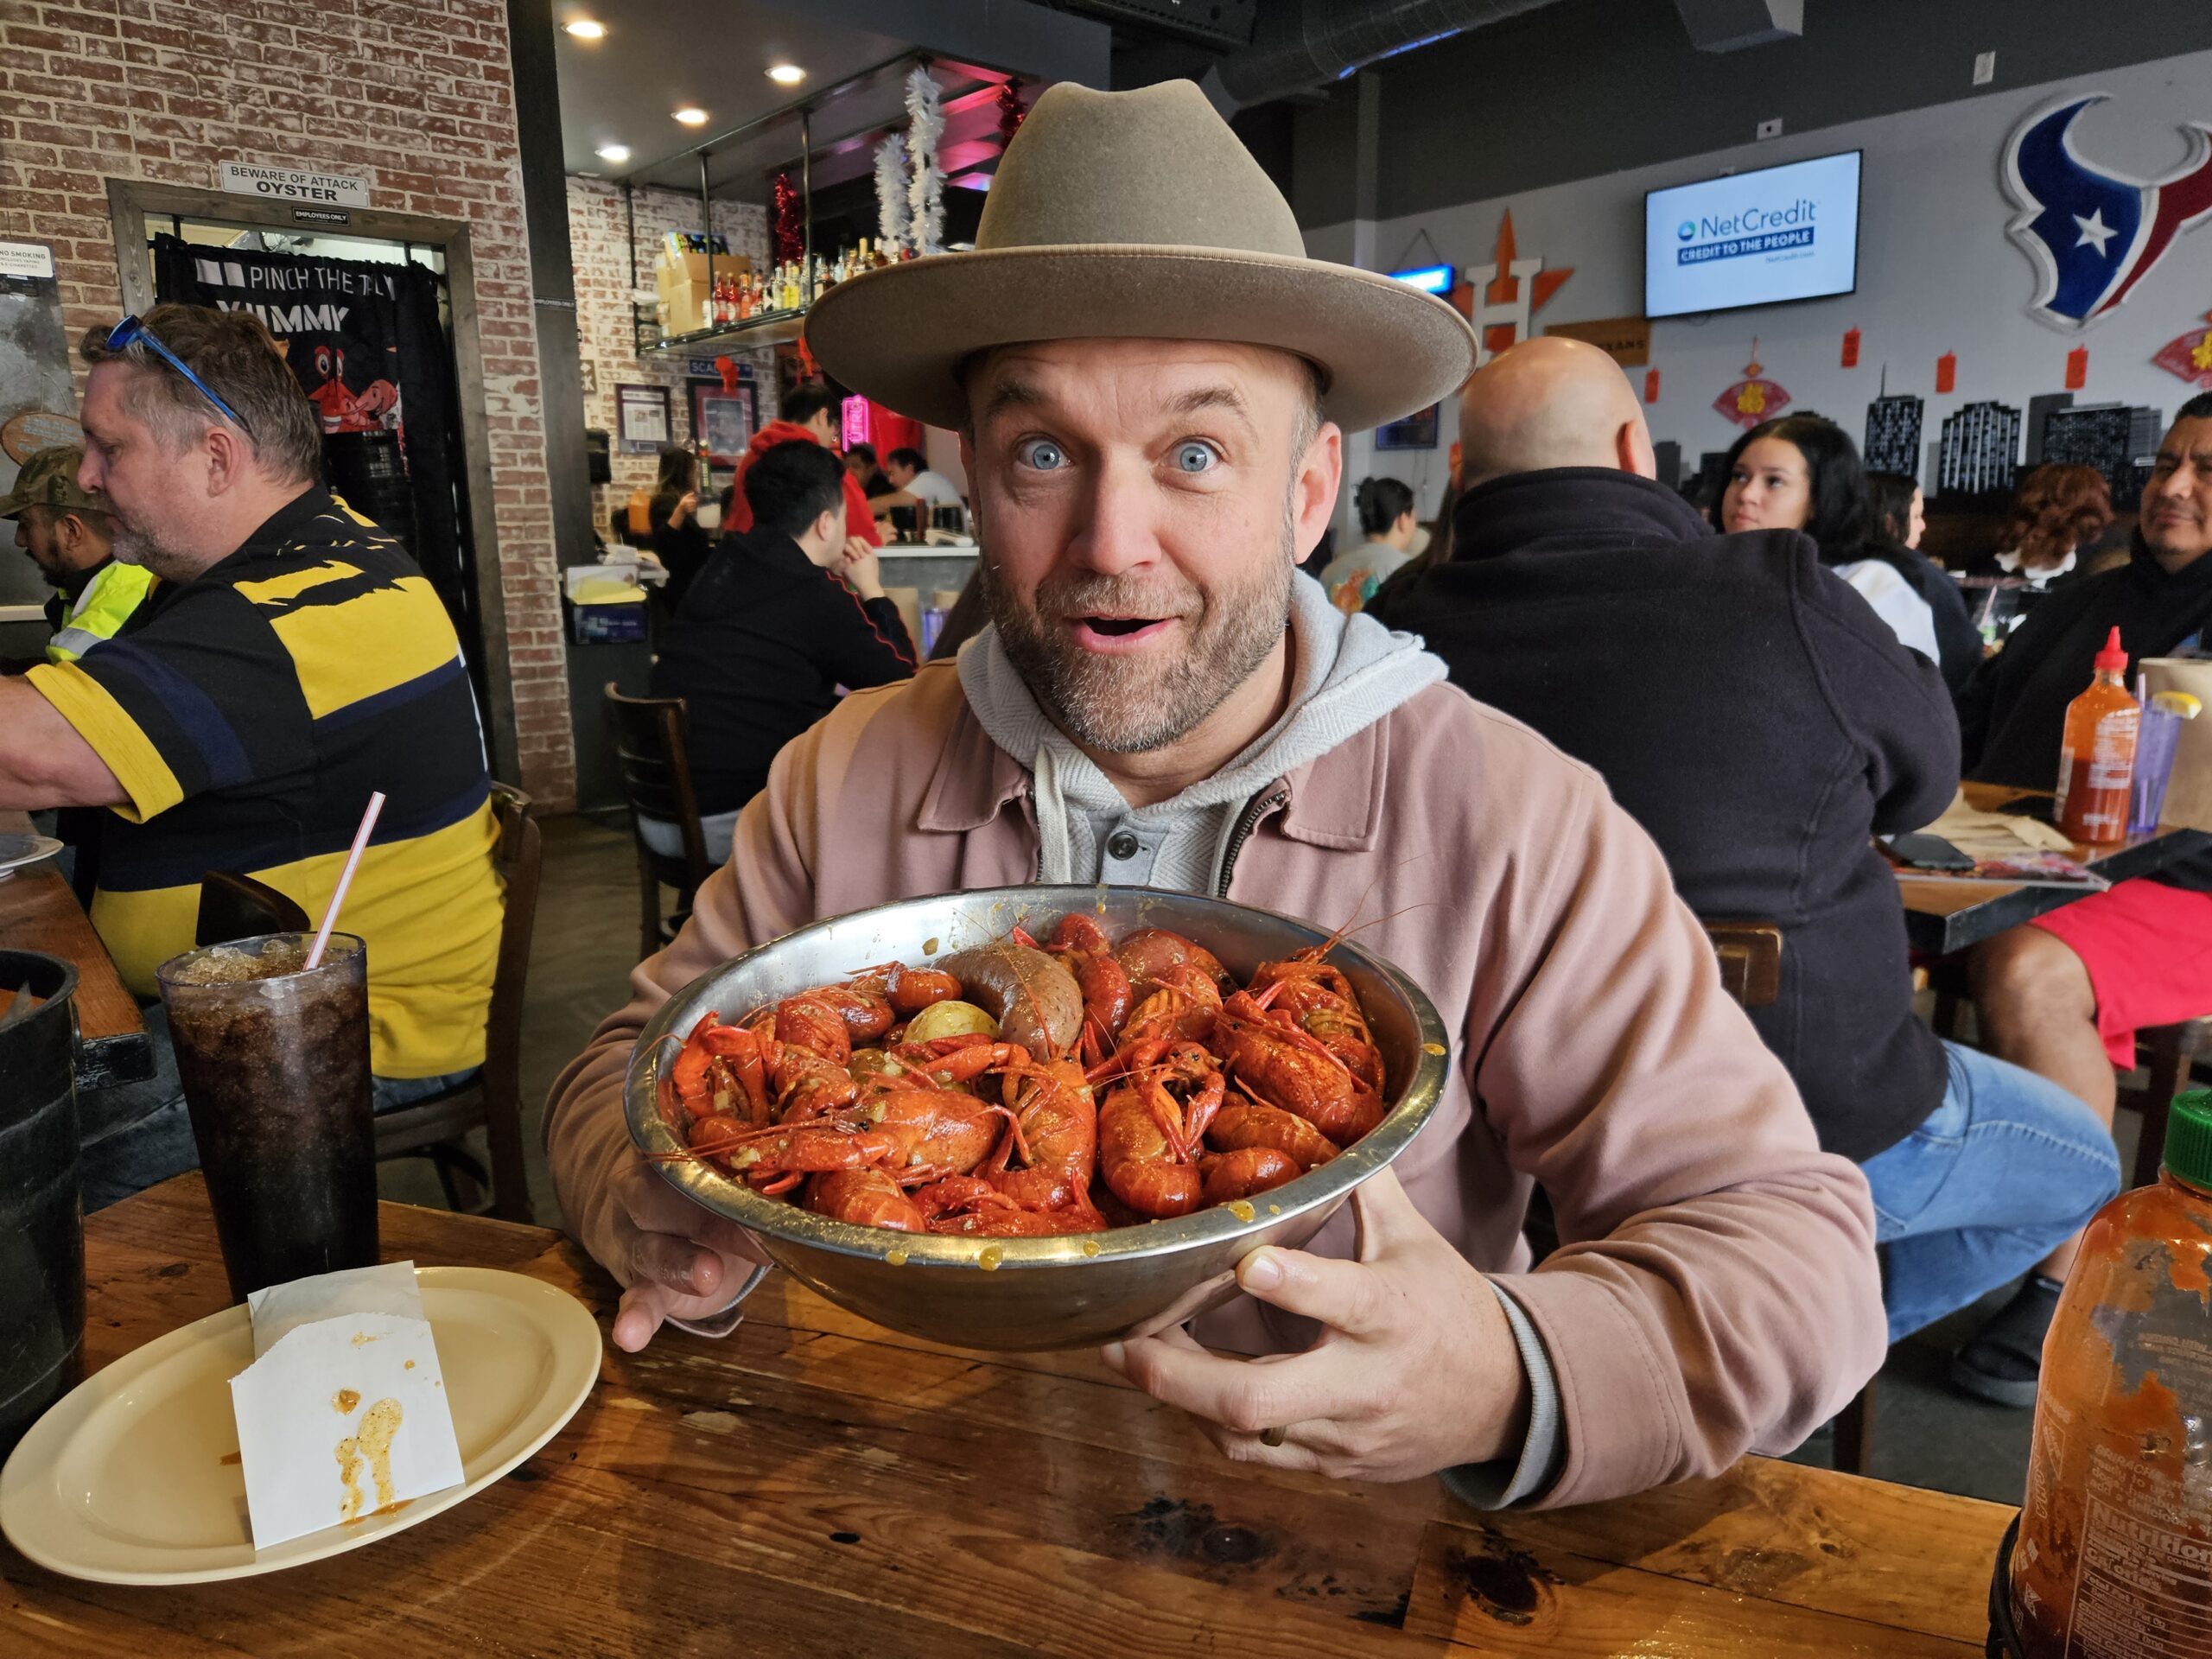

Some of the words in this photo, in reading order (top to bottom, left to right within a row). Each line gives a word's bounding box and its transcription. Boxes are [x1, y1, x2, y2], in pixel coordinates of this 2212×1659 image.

[231, 166, 286, 181] BEWARE
[290, 174, 306, 184] OF
[310, 176, 359, 191] ATTACK
[256, 181, 338, 201] OYSTER
[296, 211, 330, 219] EMPLOYEES
[1700, 199, 1817, 238] NetCredit
[10, 251, 46, 259] SMOKING
[1680, 245, 1723, 262] CREDIT
[1723, 243, 1738, 256] TO
[1740, 238, 1764, 252] THE
[1764, 230, 1811, 249] PEOPLE
[250, 266, 309, 291] PINCH
[314, 267, 353, 294] THE
[2132, 1472, 2145, 1489] to
[2087, 1547, 2161, 1592] Calories
[2082, 1570, 2109, 1592] Total
[2112, 1586, 2131, 1603] Fat
[2078, 1602, 2139, 1640] Cholesterol
[2134, 1608, 2151, 1623] Fat
